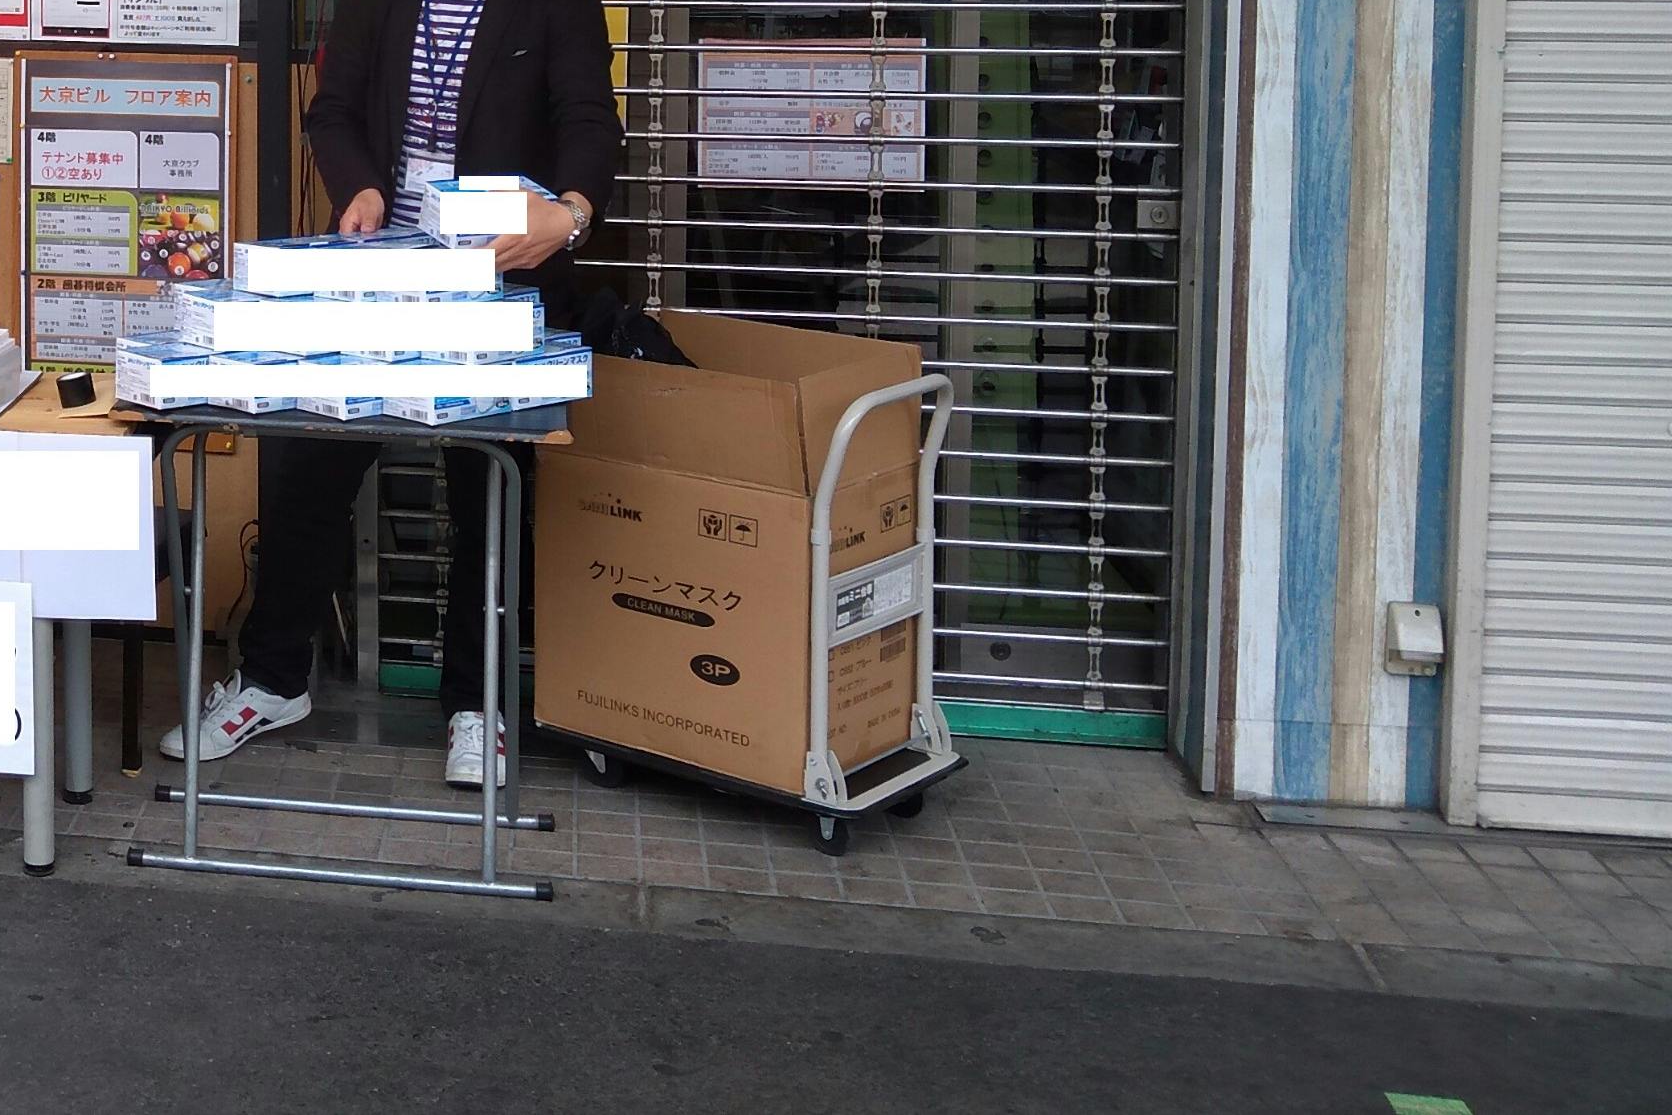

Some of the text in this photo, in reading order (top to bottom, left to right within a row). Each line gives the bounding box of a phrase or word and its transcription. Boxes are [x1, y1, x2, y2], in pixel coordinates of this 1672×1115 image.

[39, 86, 211, 107] 大京ビル フロア案内
[37, 132, 56, 143] 4階
[144, 134, 164, 145] 4階
[42, 151, 124, 165] テナント募集中
[163, 159, 199, 167] 大京クラブ
[169, 169, 193, 177] 事務所
[38, 192, 107, 204] 3階 ビリヤード
[37, 279, 126, 292] 2階 囲碁将棋会所
[589, 559, 742, 612] クリーンマスク
[626, 596, 697, 623] CLEAN MASK
[700, 661, 731, 678] 3P
[577, 689, 751, 747] FUJILINKS INCORPORATED
